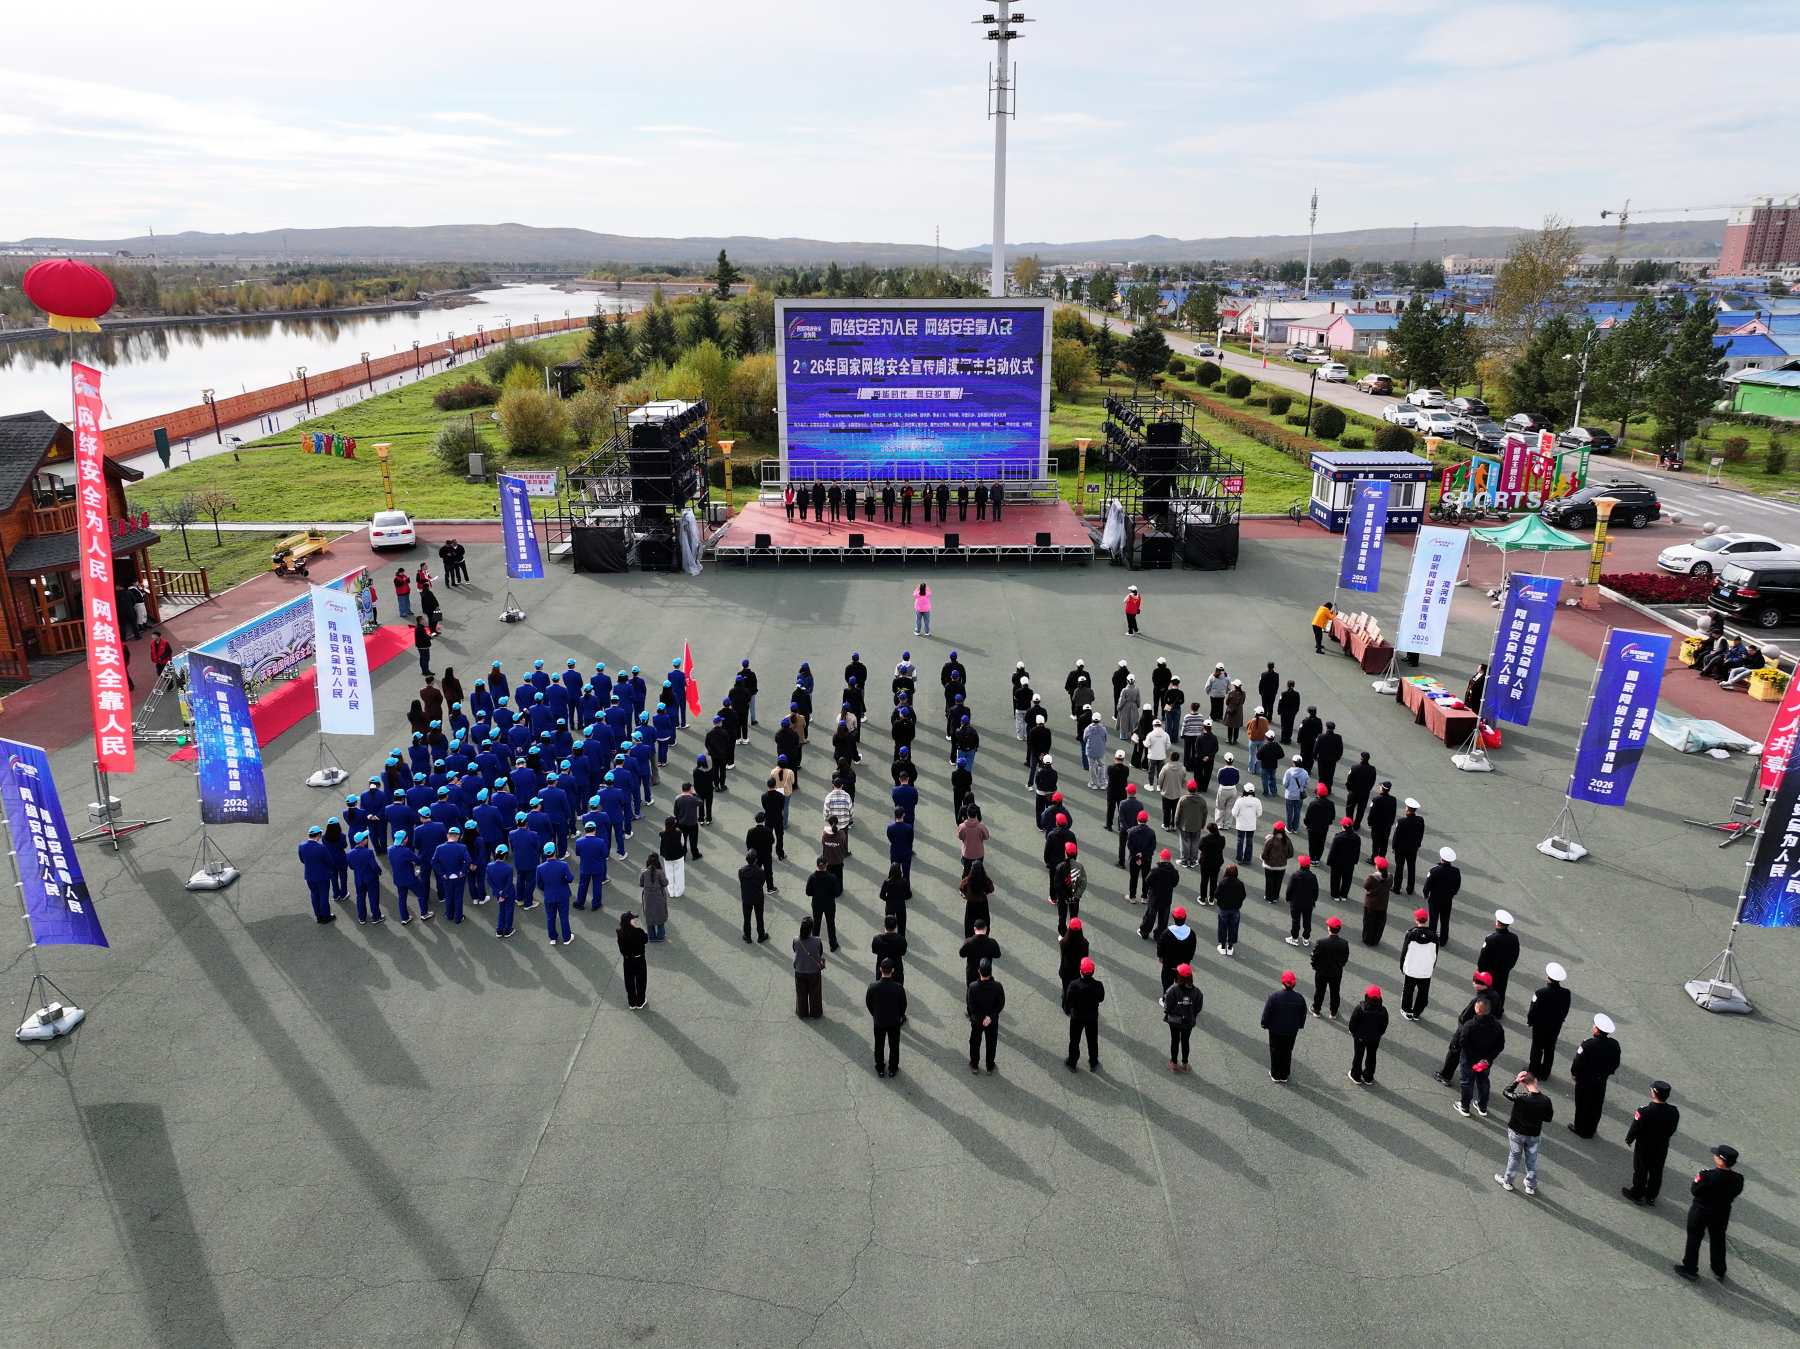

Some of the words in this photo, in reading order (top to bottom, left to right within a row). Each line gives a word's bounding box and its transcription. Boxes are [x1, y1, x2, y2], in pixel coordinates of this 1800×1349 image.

[830, 318, 917, 336] 网络安全为人民
[925, 318, 1013, 336] 网络安全靠人民
[793, 357, 1034, 376] 226年国家网络安全宣传周漠河市启动仪式
[77, 406, 108, 582] 网络安全为人民
[1441, 491, 1541, 509] SPORTS
[92, 598, 127, 756] 网络安全靠人民
[328, 620, 343, 698] 网络安全为人民
[342, 634, 359, 710] 网络安全靠人民
[1498, 608, 1527, 686] 网络安全为人民
[1510, 622, 1540, 700] 网络安全靠人民
[1601, 670, 1639, 773] 国家网络安全宣传周
[1629, 707, 1648, 741] 漠河市
[224, 799, 248, 807] 2026
[1590, 779, 1614, 789] 2026
[20, 787, 60, 896] 网络安全为人民
[40, 808, 84, 914] 网络安全靠人民
